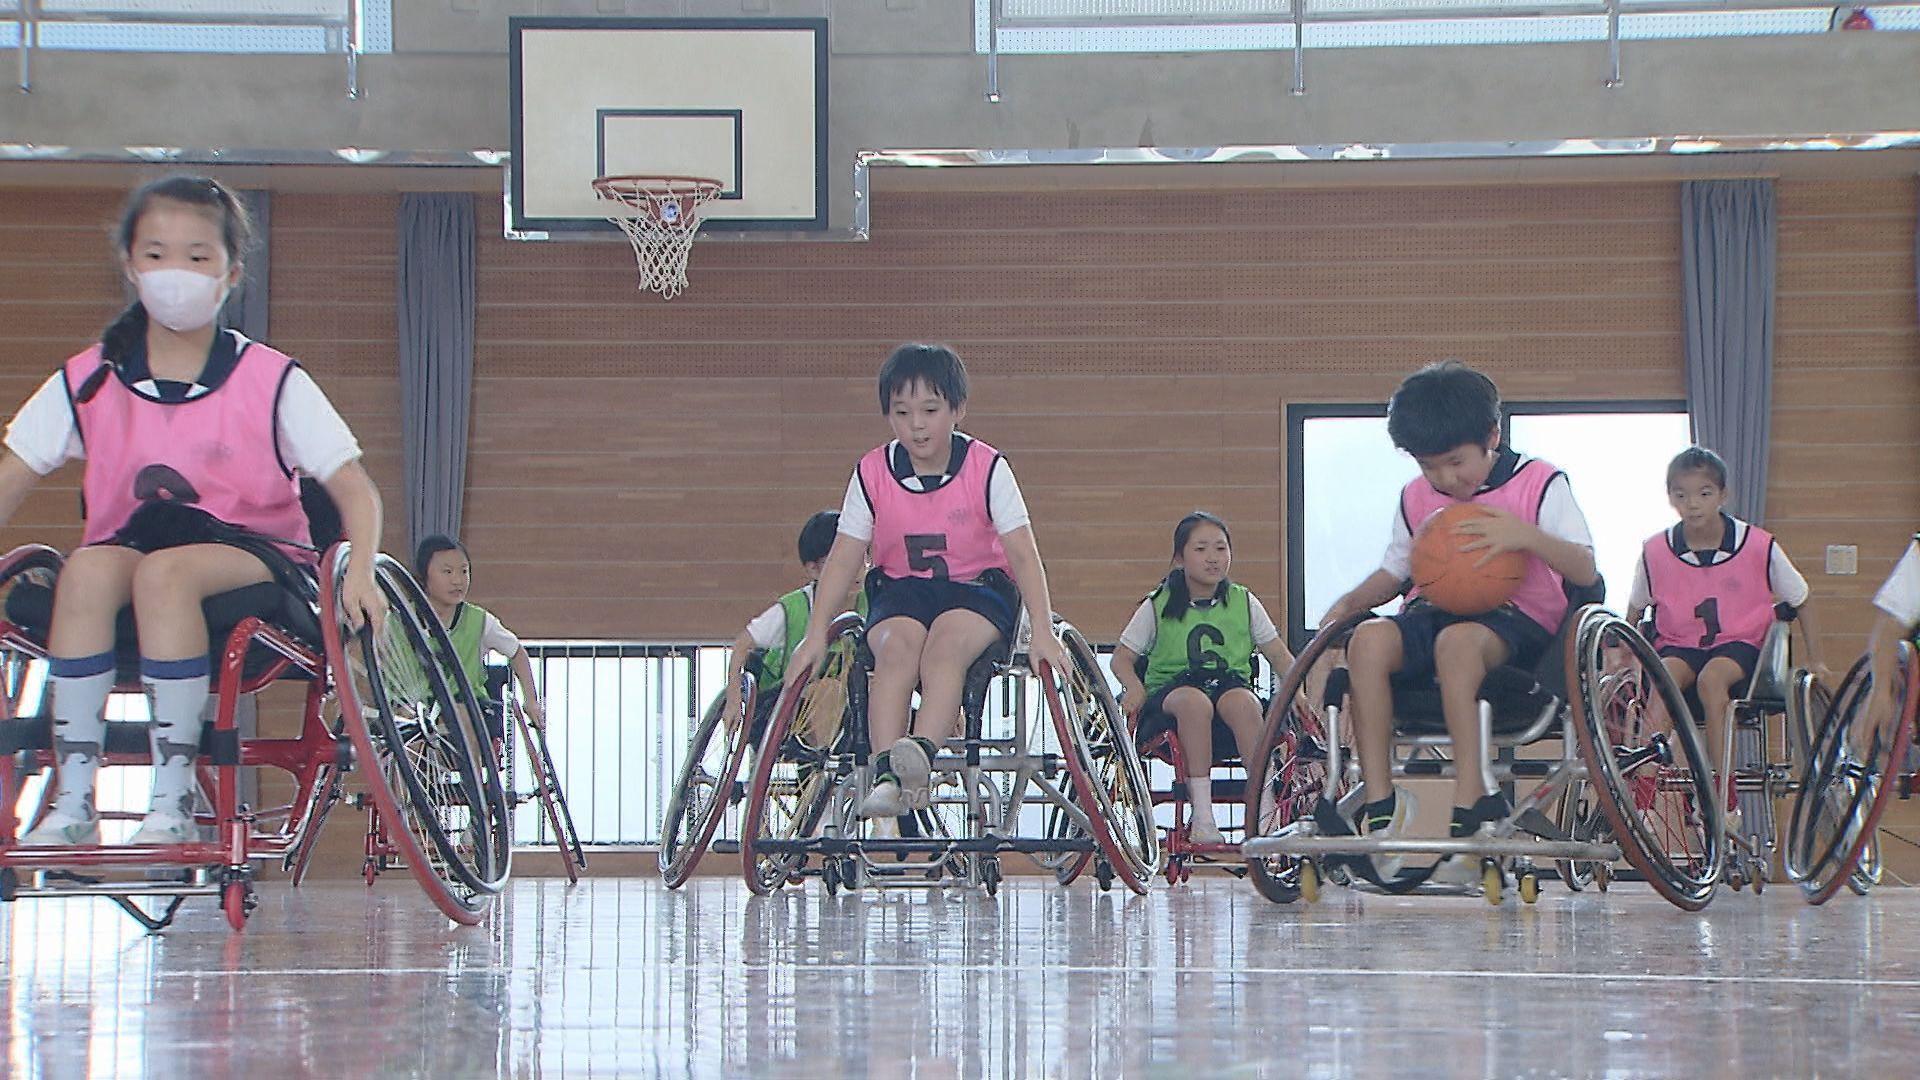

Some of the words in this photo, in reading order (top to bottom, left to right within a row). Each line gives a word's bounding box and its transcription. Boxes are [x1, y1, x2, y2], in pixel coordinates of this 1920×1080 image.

[904, 534, 949, 580] 5
[1694, 598, 1721, 647] 1
[1187, 624, 1229, 673] 6
